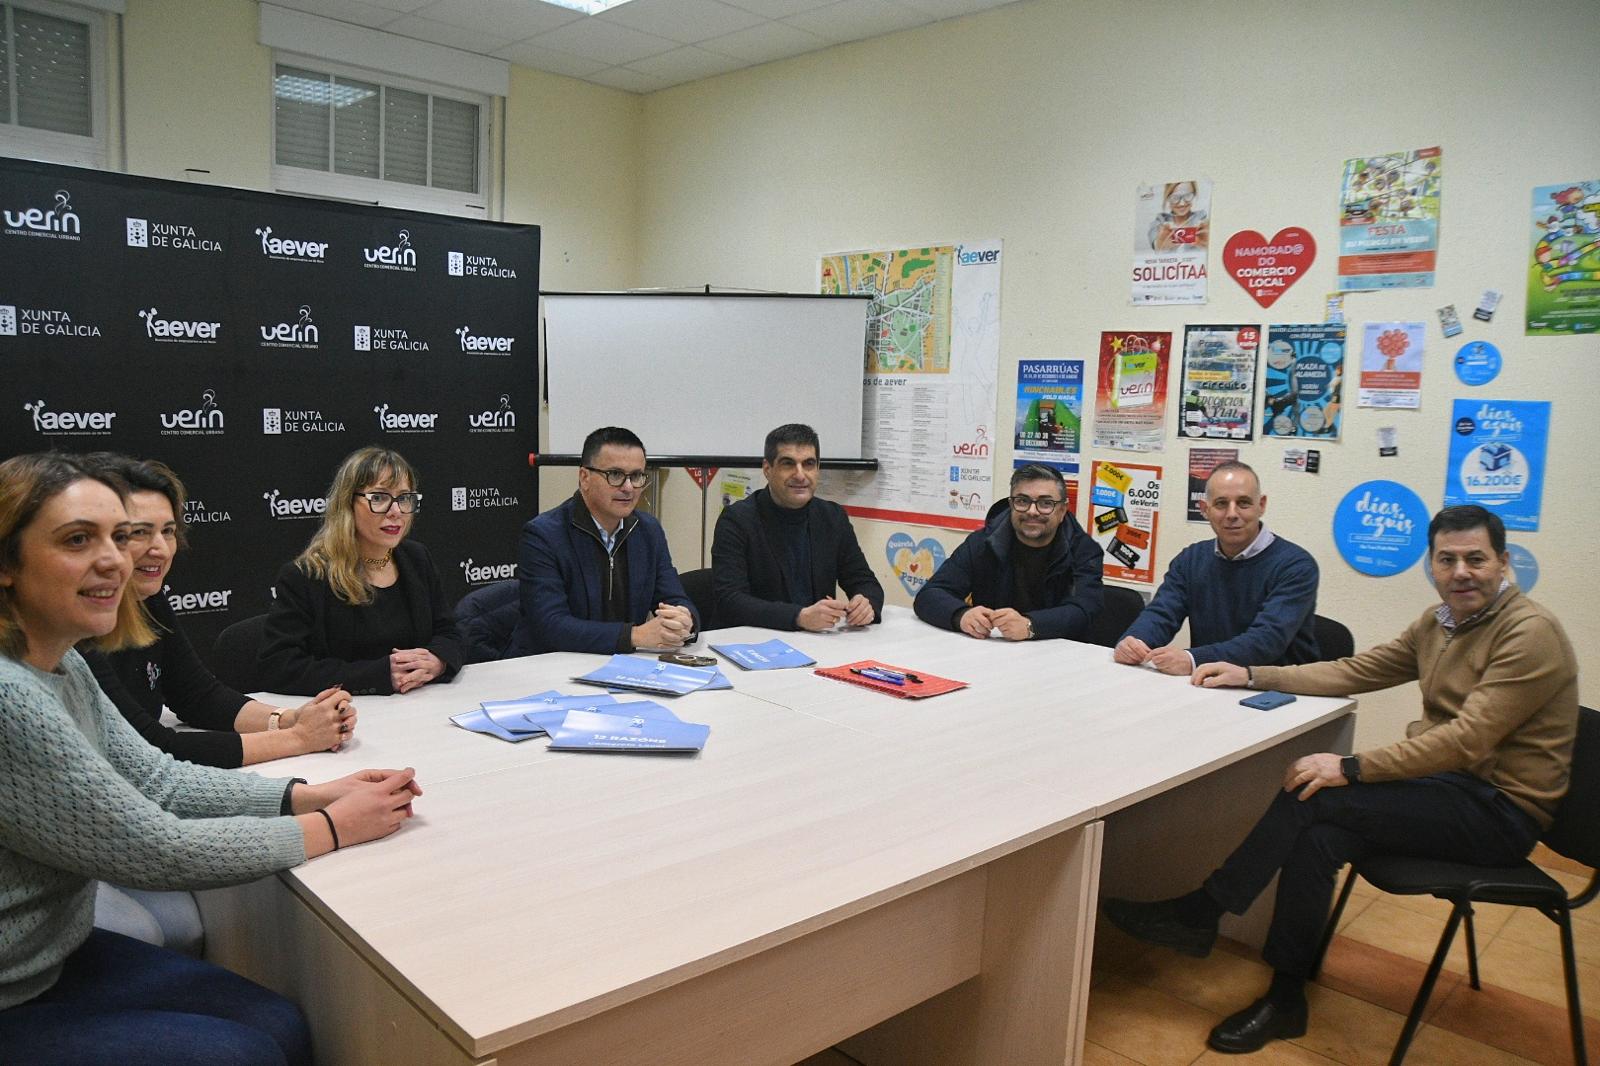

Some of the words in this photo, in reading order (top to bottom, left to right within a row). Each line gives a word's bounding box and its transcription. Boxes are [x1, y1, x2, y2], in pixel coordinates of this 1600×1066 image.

[152, 223, 196, 238] XUNTA
[152, 237, 168, 247] DE
[173, 238, 222, 252] GALICIA
[268, 237, 329, 259] aever
[466, 255, 498, 268] XUNTA
[963, 249, 1000, 264] aever
[1258, 256, 1275, 266] DO
[466, 268, 479, 276] DE
[481, 268, 517, 279] GALICIA
[1236, 265, 1296, 278] COMERCIO
[1249, 277, 1285, 288] LOCAL
[21, 308, 71, 324] XUNTA
[21, 323, 40, 334] DE
[44, 324, 102, 340] GALICIA
[153, 319, 221, 339] aever
[373, 328, 408, 340] XUNTA
[1243, 331, 1255, 340] 15
[373, 340, 387, 350] DE
[389, 340, 429, 352] GALICIA
[464, 333, 514, 352] aever
[41, 411, 117, 430] aever
[285, 409, 322, 421] XUNTA
[386, 412, 438, 430] aever
[285, 421, 300, 432] DE
[302, 421, 345, 432] GALICIA
[1147, 480, 1160, 490] Os
[1466, 474, 1523, 487] 16.200€
[469, 488, 500, 497] XUNTA
[1128, 488, 1159, 500] 6.000
[277, 498, 329, 515] aeve
[469, 498, 481, 508] DE
[484, 497, 519, 508] GALICIA
[183, 511, 231, 524] GALICIA
[470, 563, 518, 581] aever
[168, 589, 232, 612] aever
